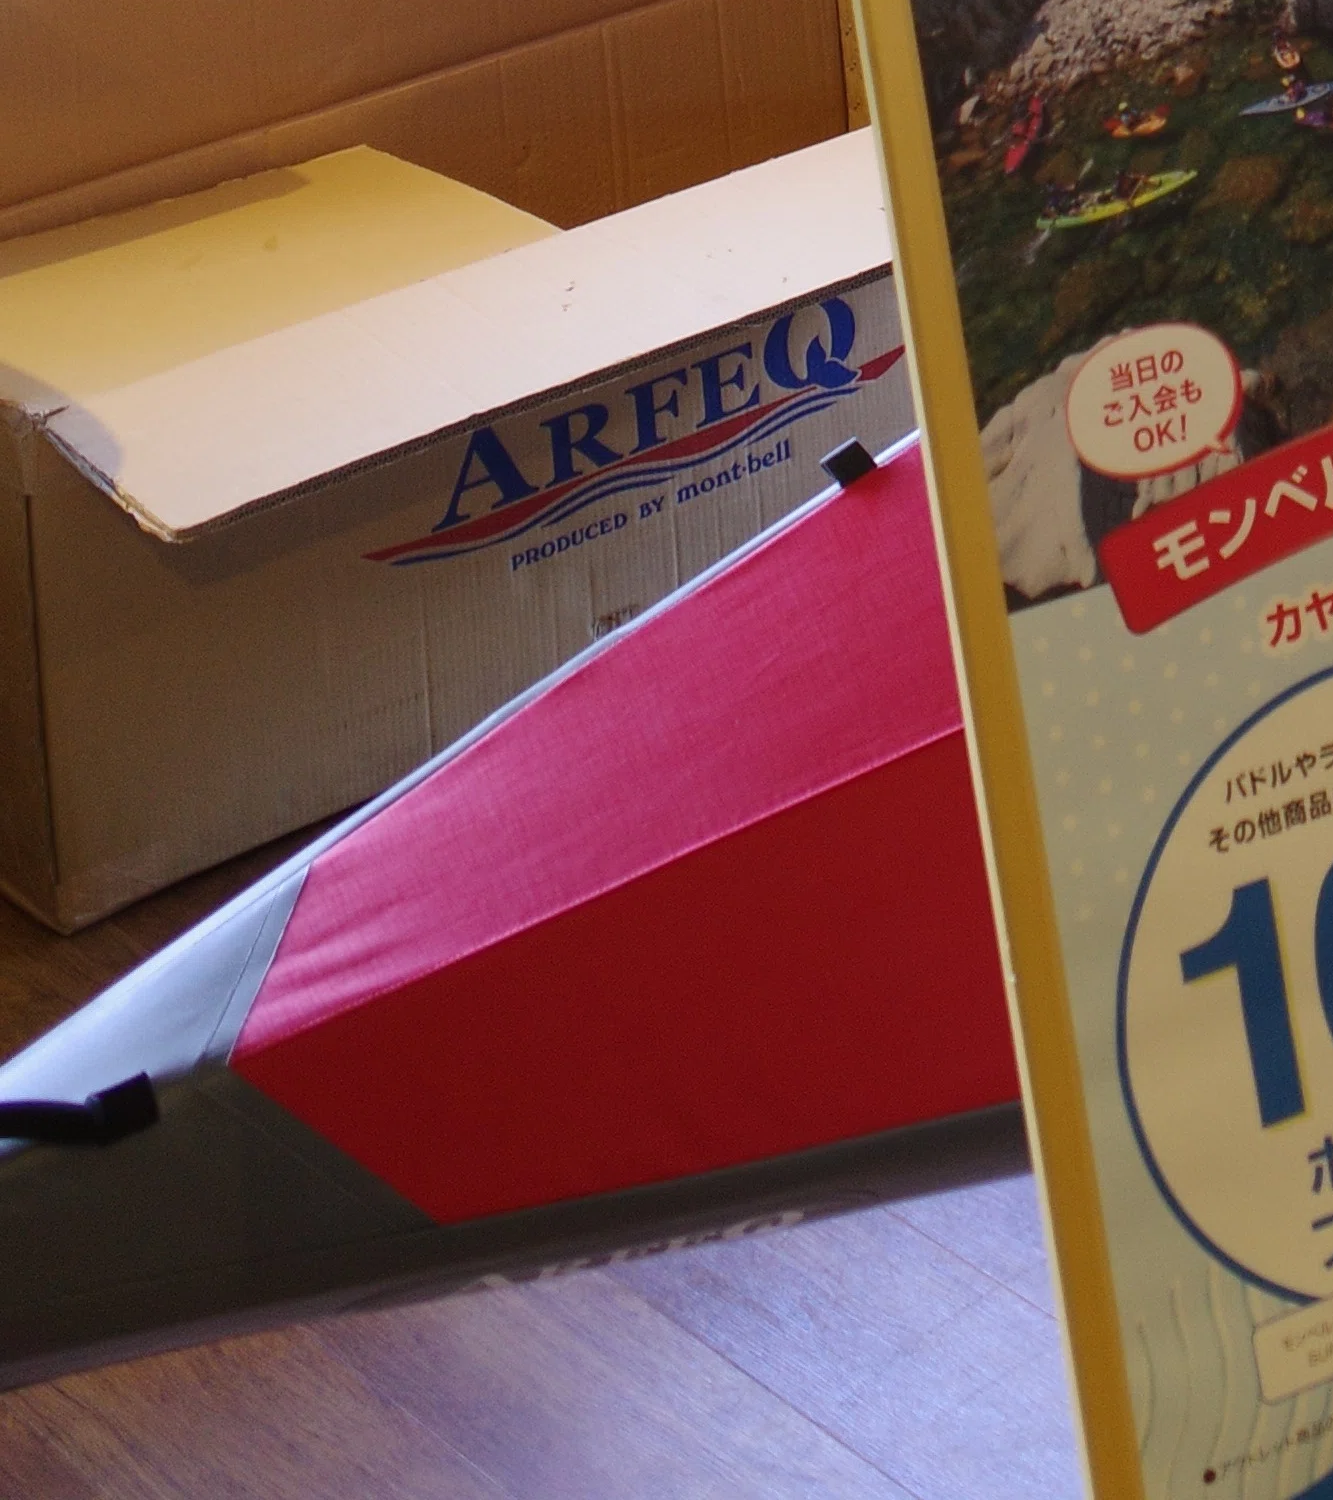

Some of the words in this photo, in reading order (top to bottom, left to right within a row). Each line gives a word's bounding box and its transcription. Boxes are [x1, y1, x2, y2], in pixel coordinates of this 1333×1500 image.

[1108, 348, 1186, 392] 当日の
[432, 296, 860, 534] ARFEQ
[1102, 377, 1204, 428] ご入会も
[1133, 418, 1189, 449] OK!
[511, 513, 628, 571] PRODUCED
[639, 496, 664, 520] BY
